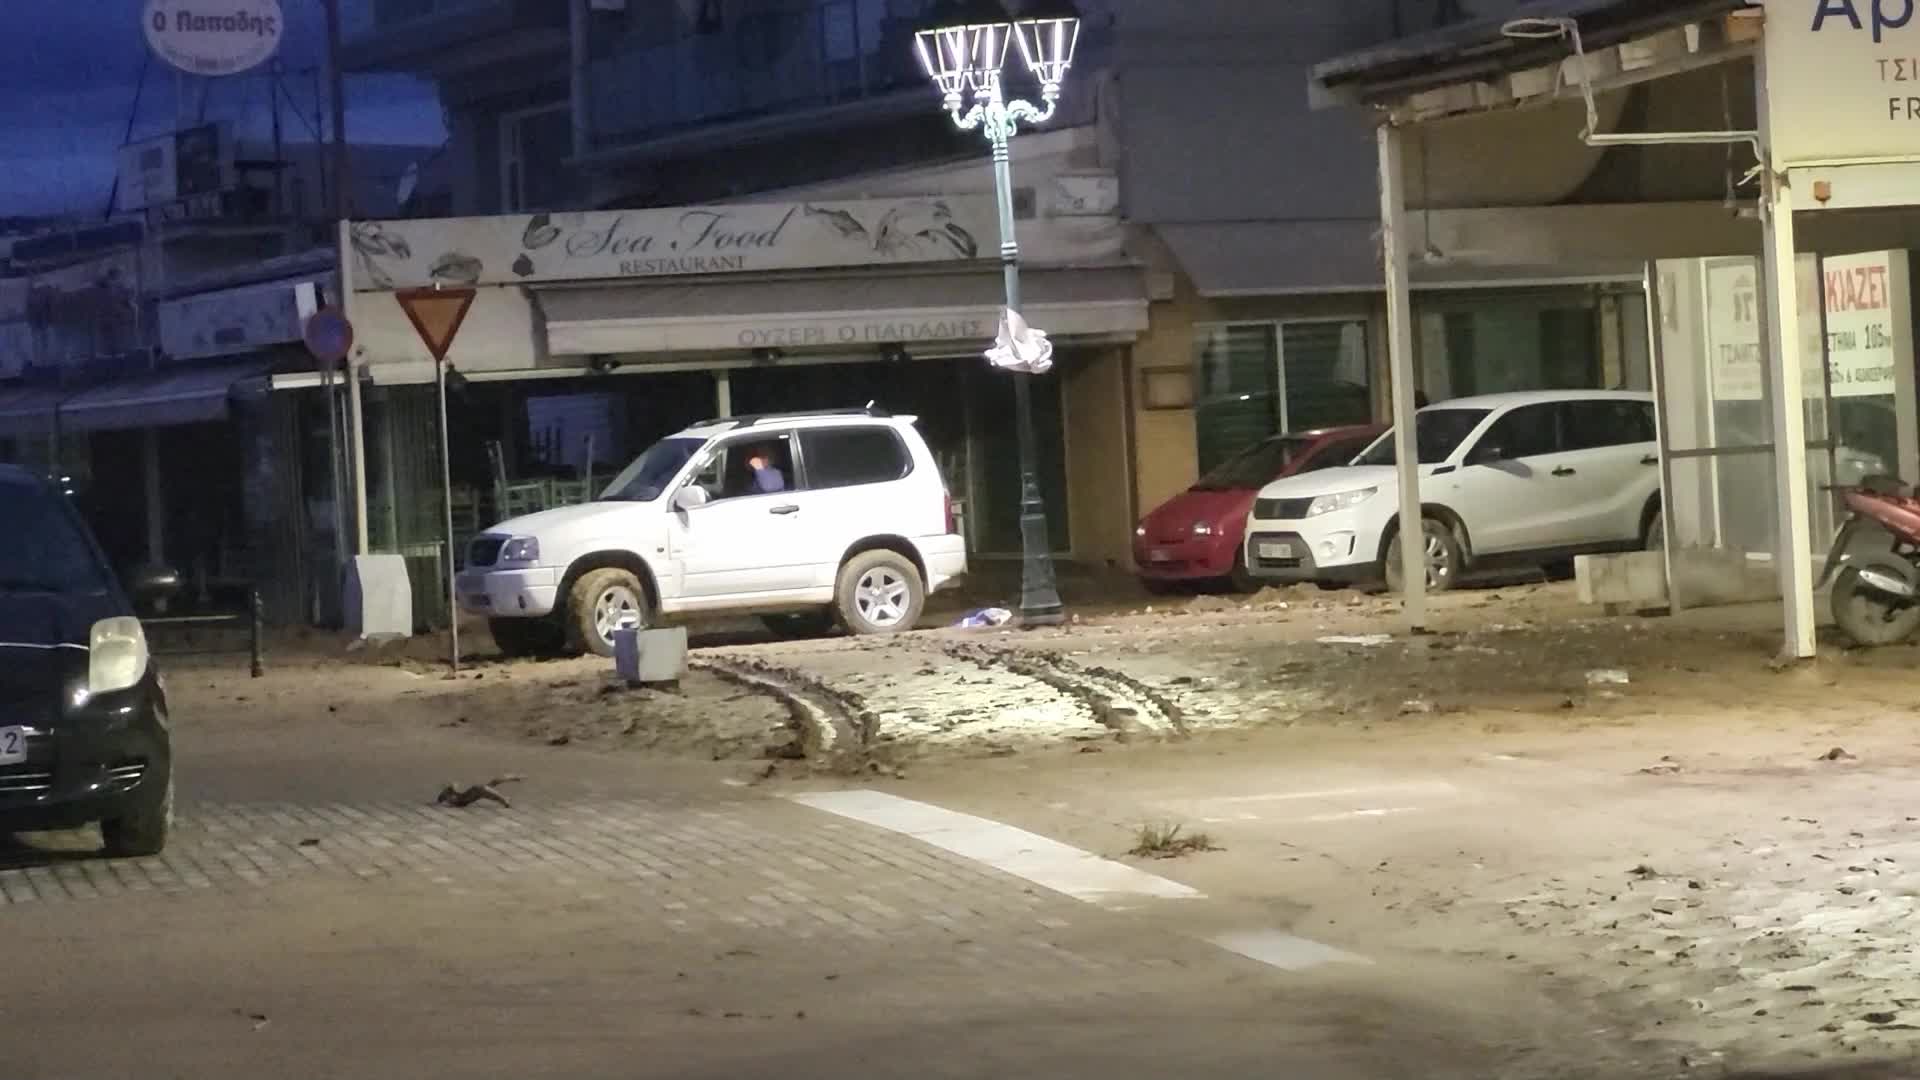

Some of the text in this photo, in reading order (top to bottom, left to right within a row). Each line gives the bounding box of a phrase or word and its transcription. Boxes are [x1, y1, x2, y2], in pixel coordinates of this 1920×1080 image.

[566, 205, 797, 257] Sea Food
[619, 255, 744, 274] RESTAURANT
[864, 319, 984, 340] ΠΑΠΑΔΗΣ
